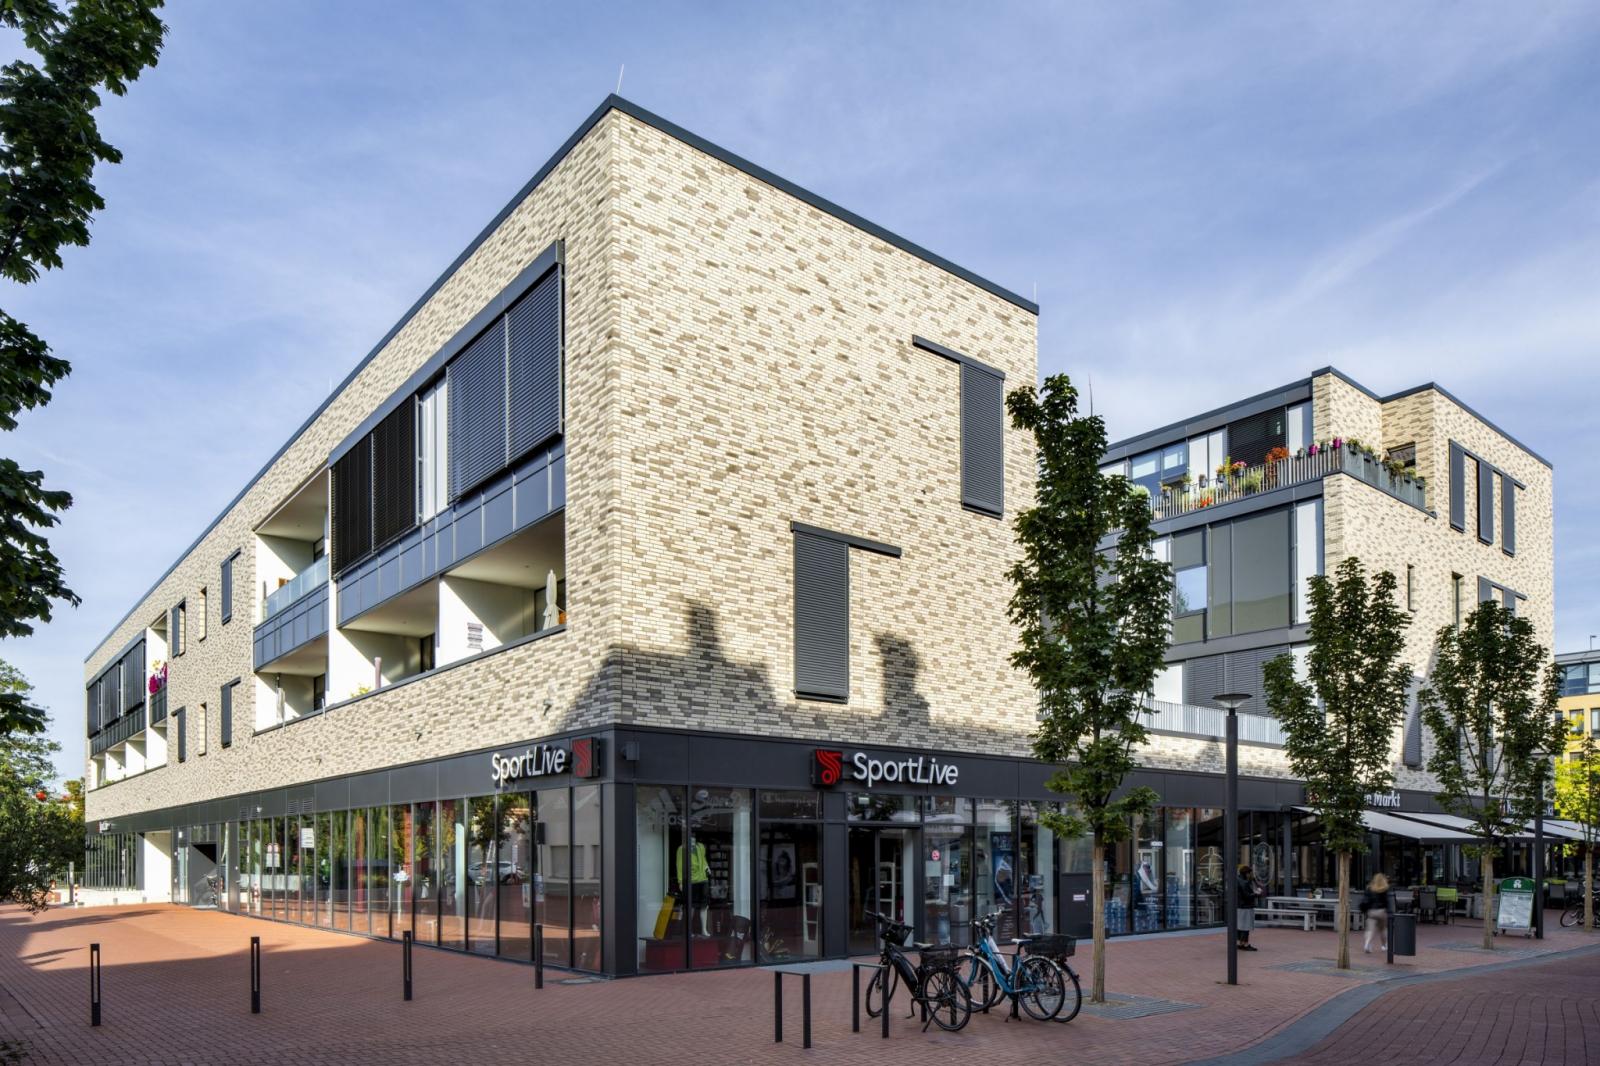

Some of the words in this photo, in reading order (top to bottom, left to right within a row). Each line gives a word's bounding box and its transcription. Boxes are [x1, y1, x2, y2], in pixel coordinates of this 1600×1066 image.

[492, 745, 566, 787] SportLive
[853, 752, 958, 787] SportLive
[1373, 789, 1401, 807] Markt
